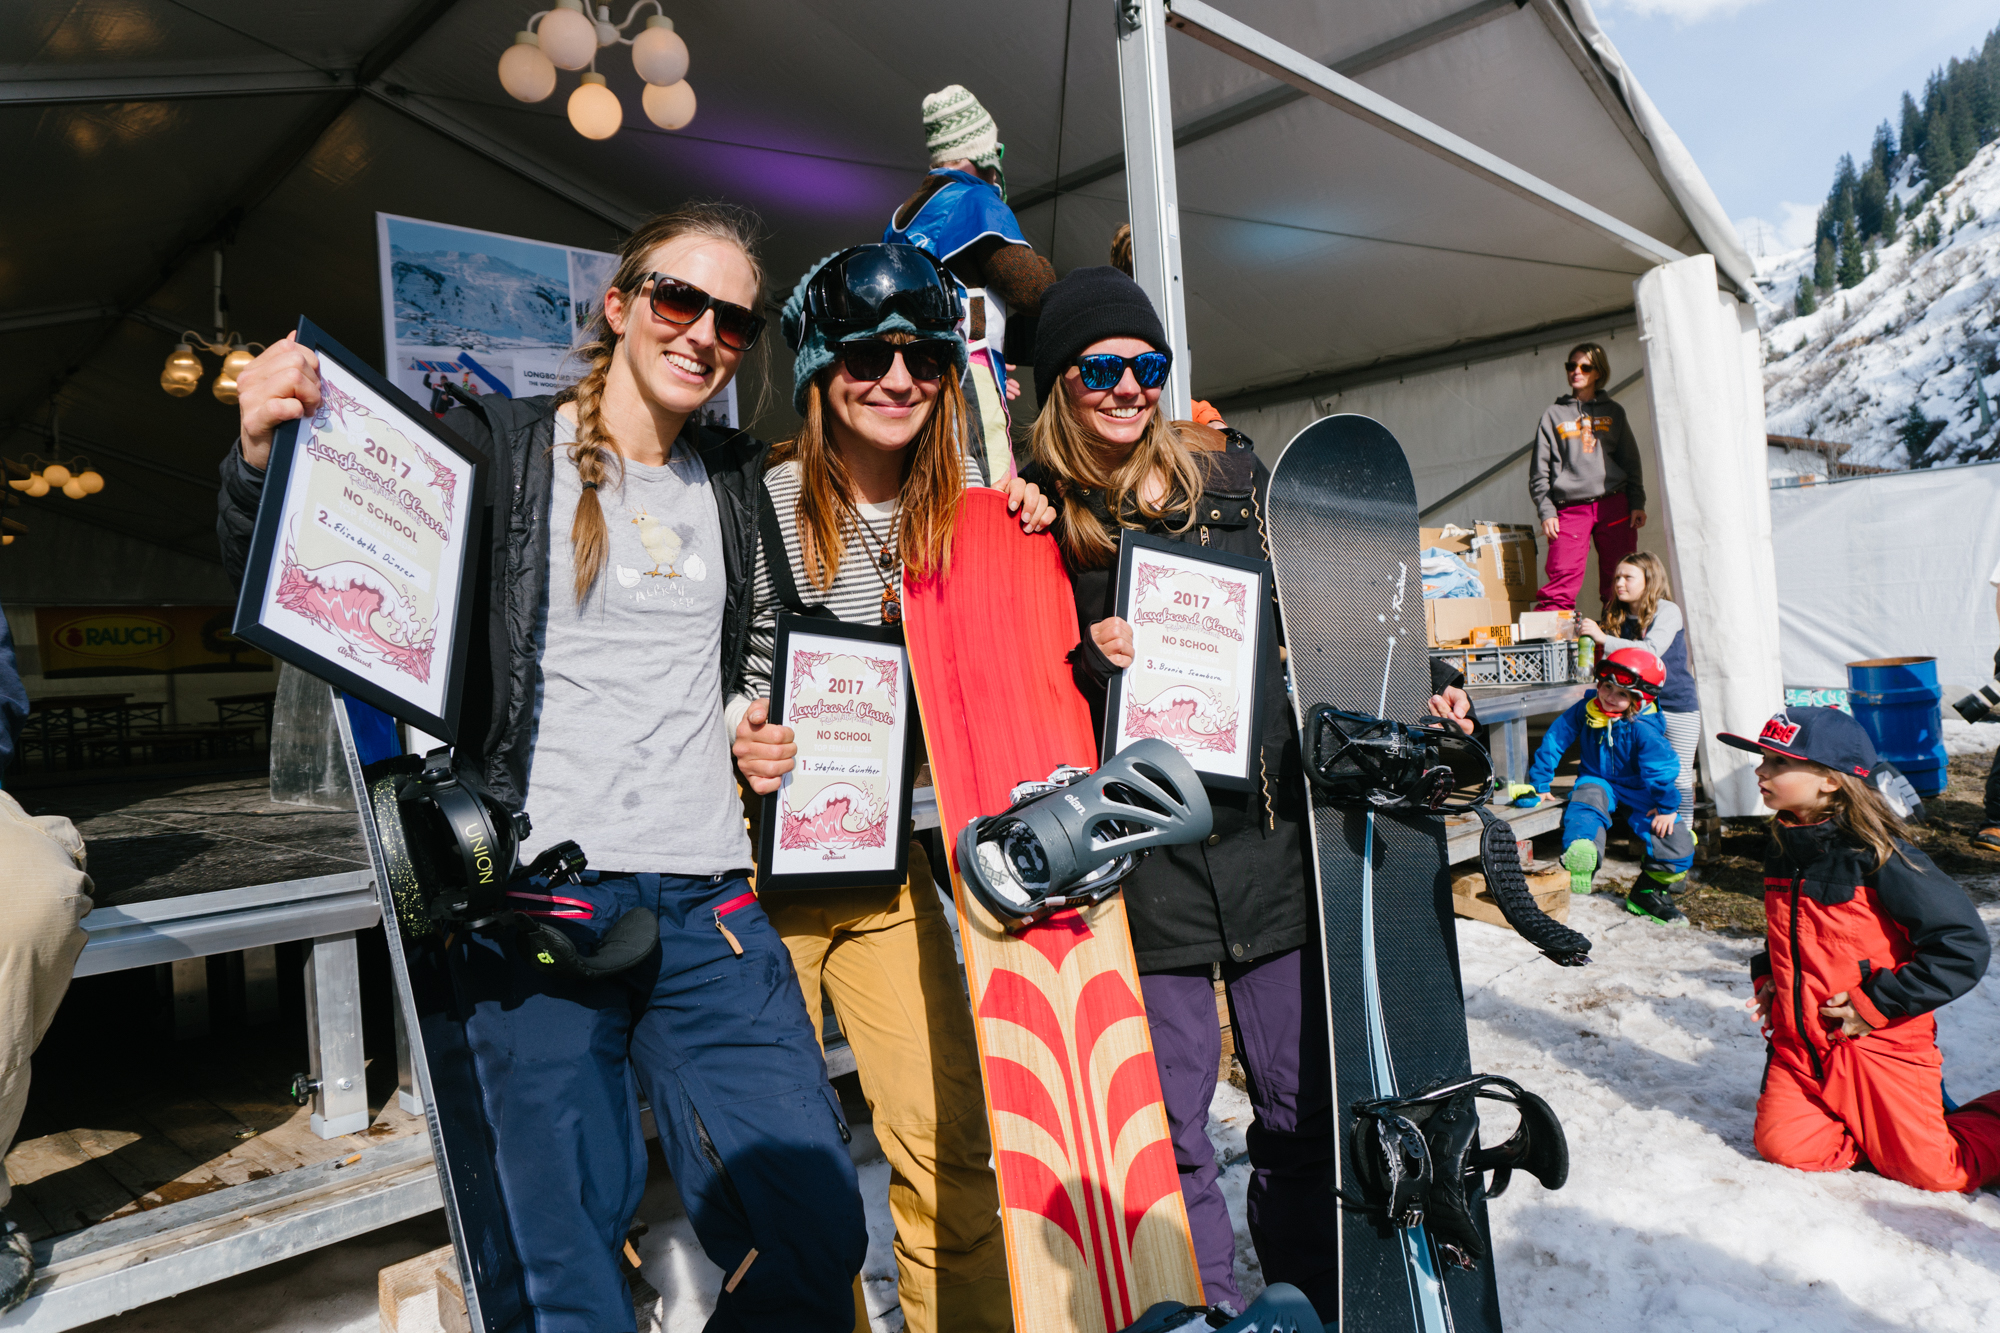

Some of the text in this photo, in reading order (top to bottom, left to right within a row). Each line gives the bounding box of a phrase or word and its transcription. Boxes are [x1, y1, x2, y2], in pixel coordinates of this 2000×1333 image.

[364, 438, 411, 479] 2017
[307, 435, 449, 541] Longboard Classic
[343, 486, 418, 543] NO SCHOOL
[318, 510, 331, 528] 2.
[333, 523, 377, 555] Elisabeth
[1173, 590, 1210, 609] 2017
[1134, 607, 1243, 642] Longboard Classic
[1491, 626, 1512, 637] BRETT
[85, 626, 162, 646] RAUCH
[1162, 635, 1219, 654] NO SCHOOL
[1146, 659, 1157, 670] 3.
[828, 678, 864, 695] 2017
[789, 698, 894, 725] Longboard Classic
[816, 730, 872, 742] NO SCHOOL
[802, 760, 880, 775] 1. Stefanie Günther
[465, 822, 494, 884] UNION
